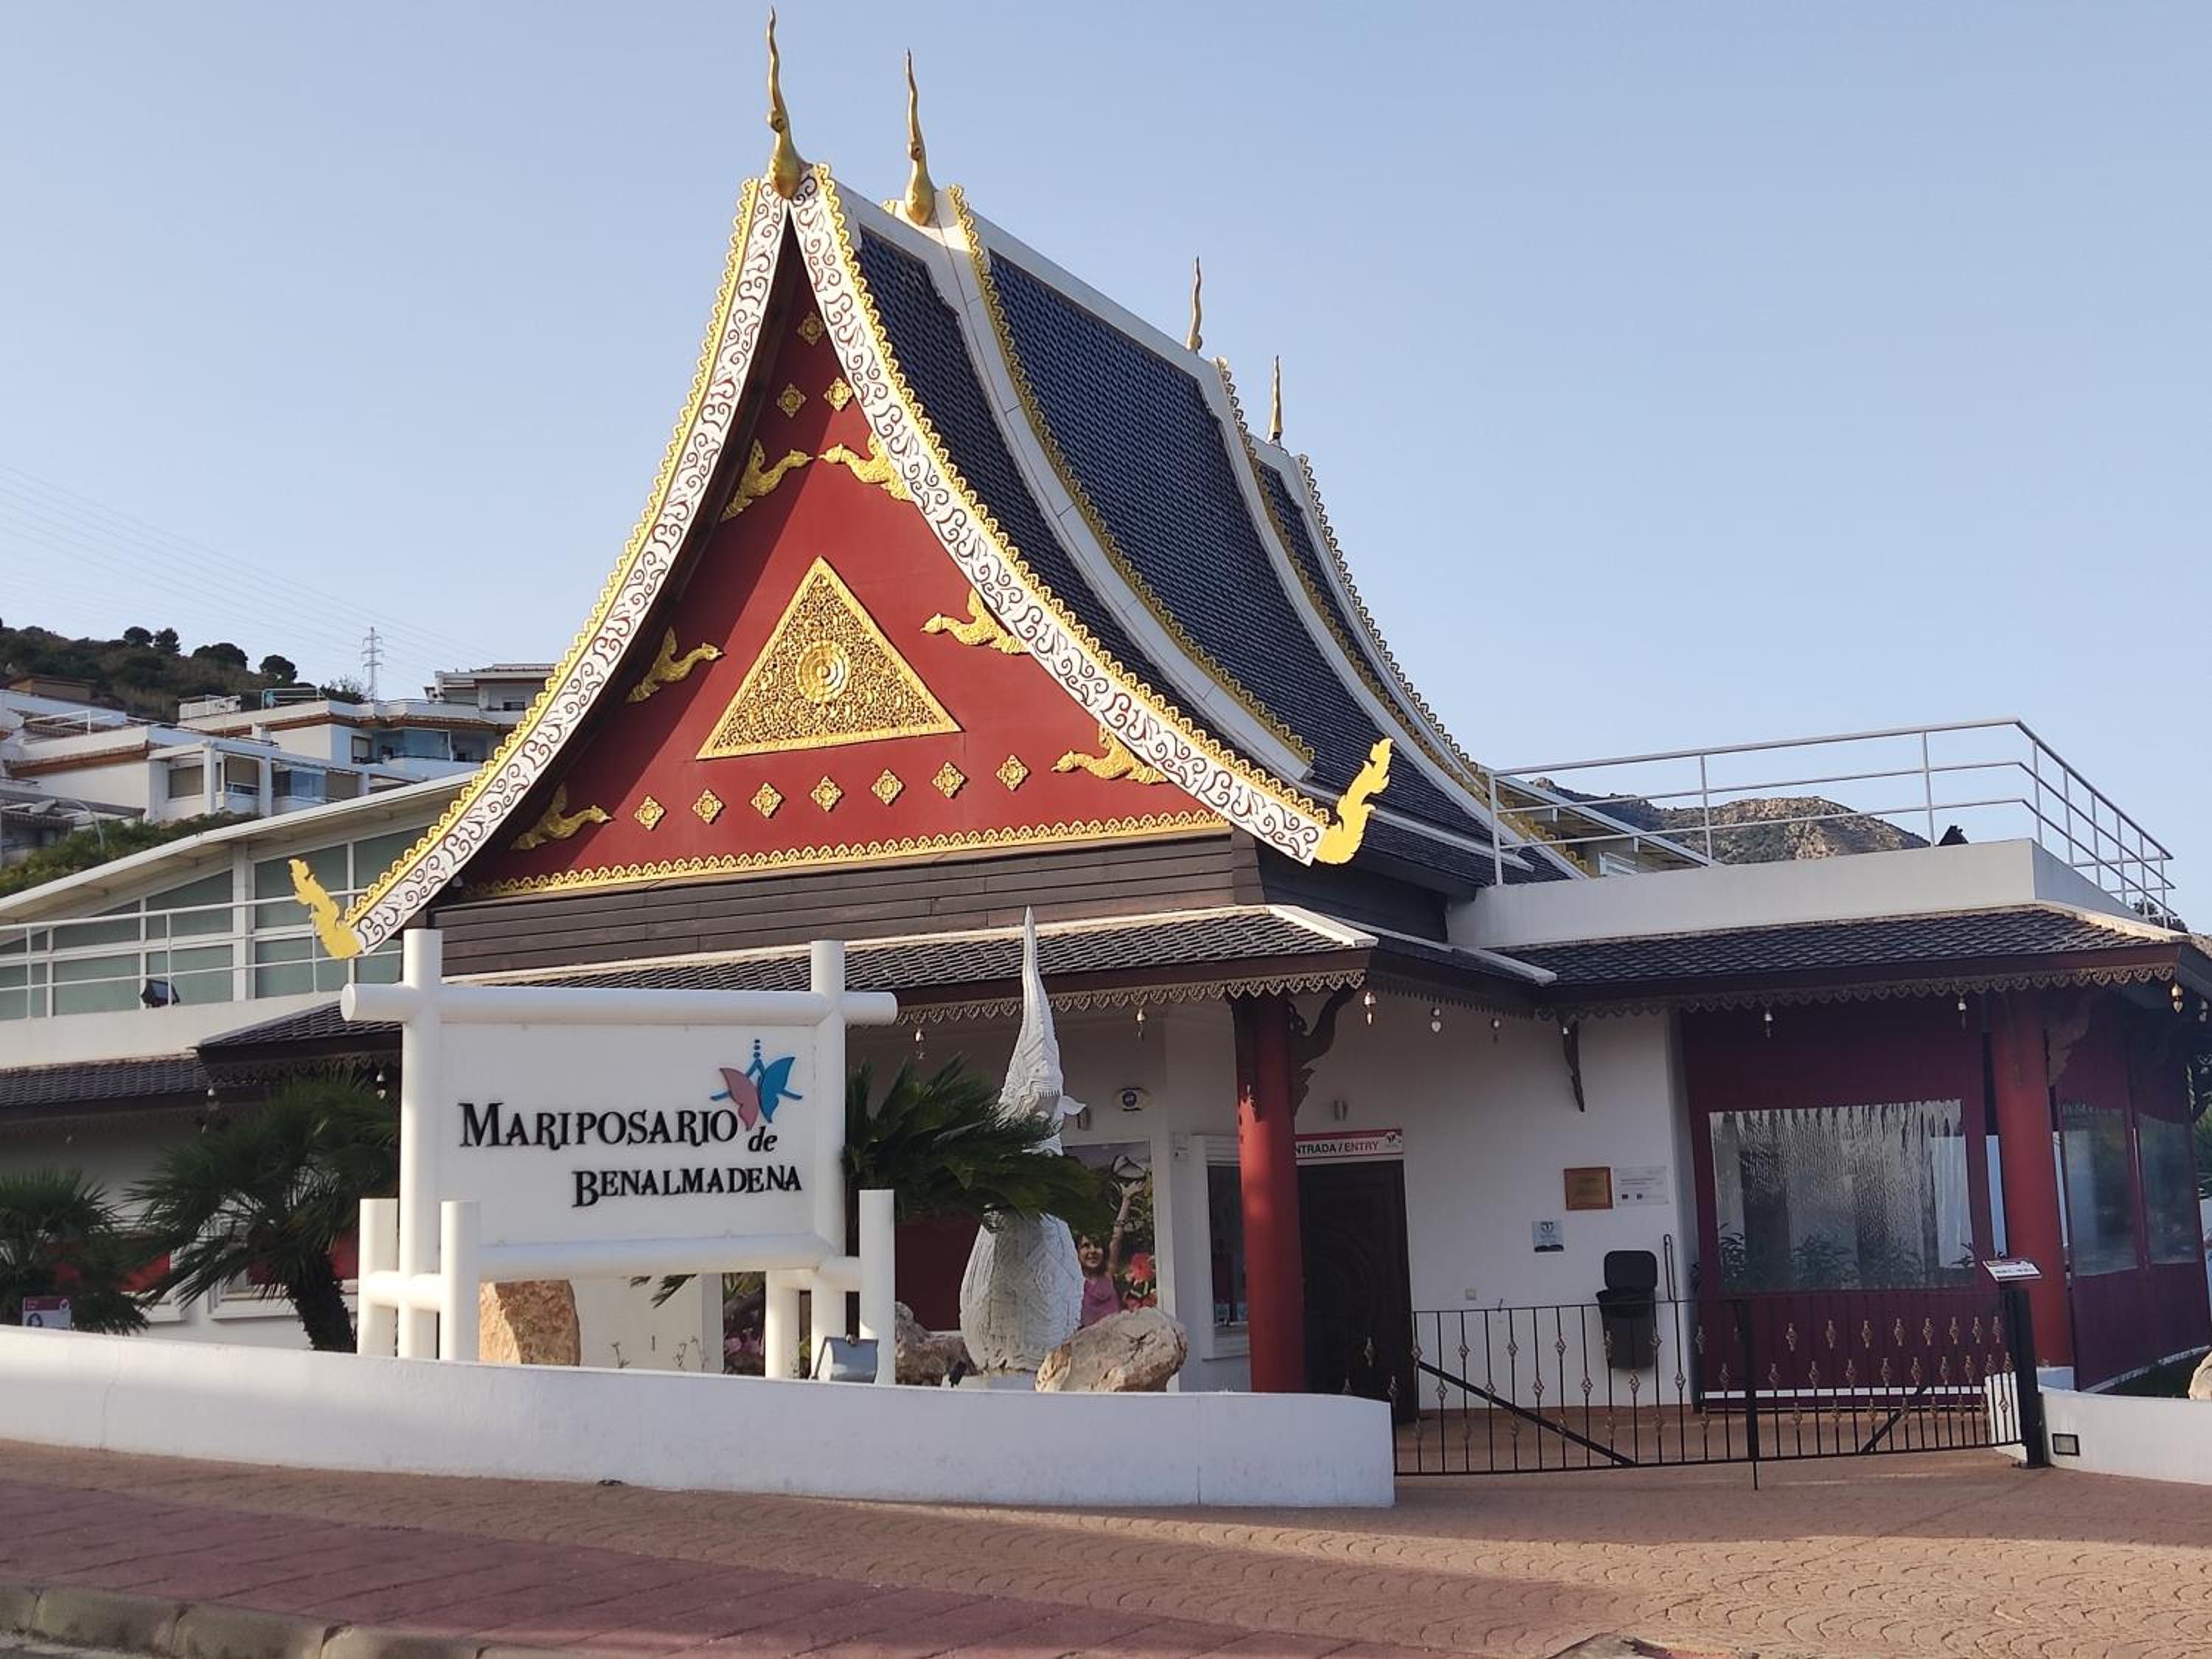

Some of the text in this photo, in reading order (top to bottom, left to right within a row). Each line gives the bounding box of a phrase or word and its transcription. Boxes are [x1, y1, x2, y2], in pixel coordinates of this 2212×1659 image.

[458, 1102, 778, 1152] MARIPOSARIO de
[1297, 1143, 1337, 1154] NTRADA
[1344, 1141, 1379, 1152] ENTRY
[571, 1165, 803, 1208] BENALMADENA
